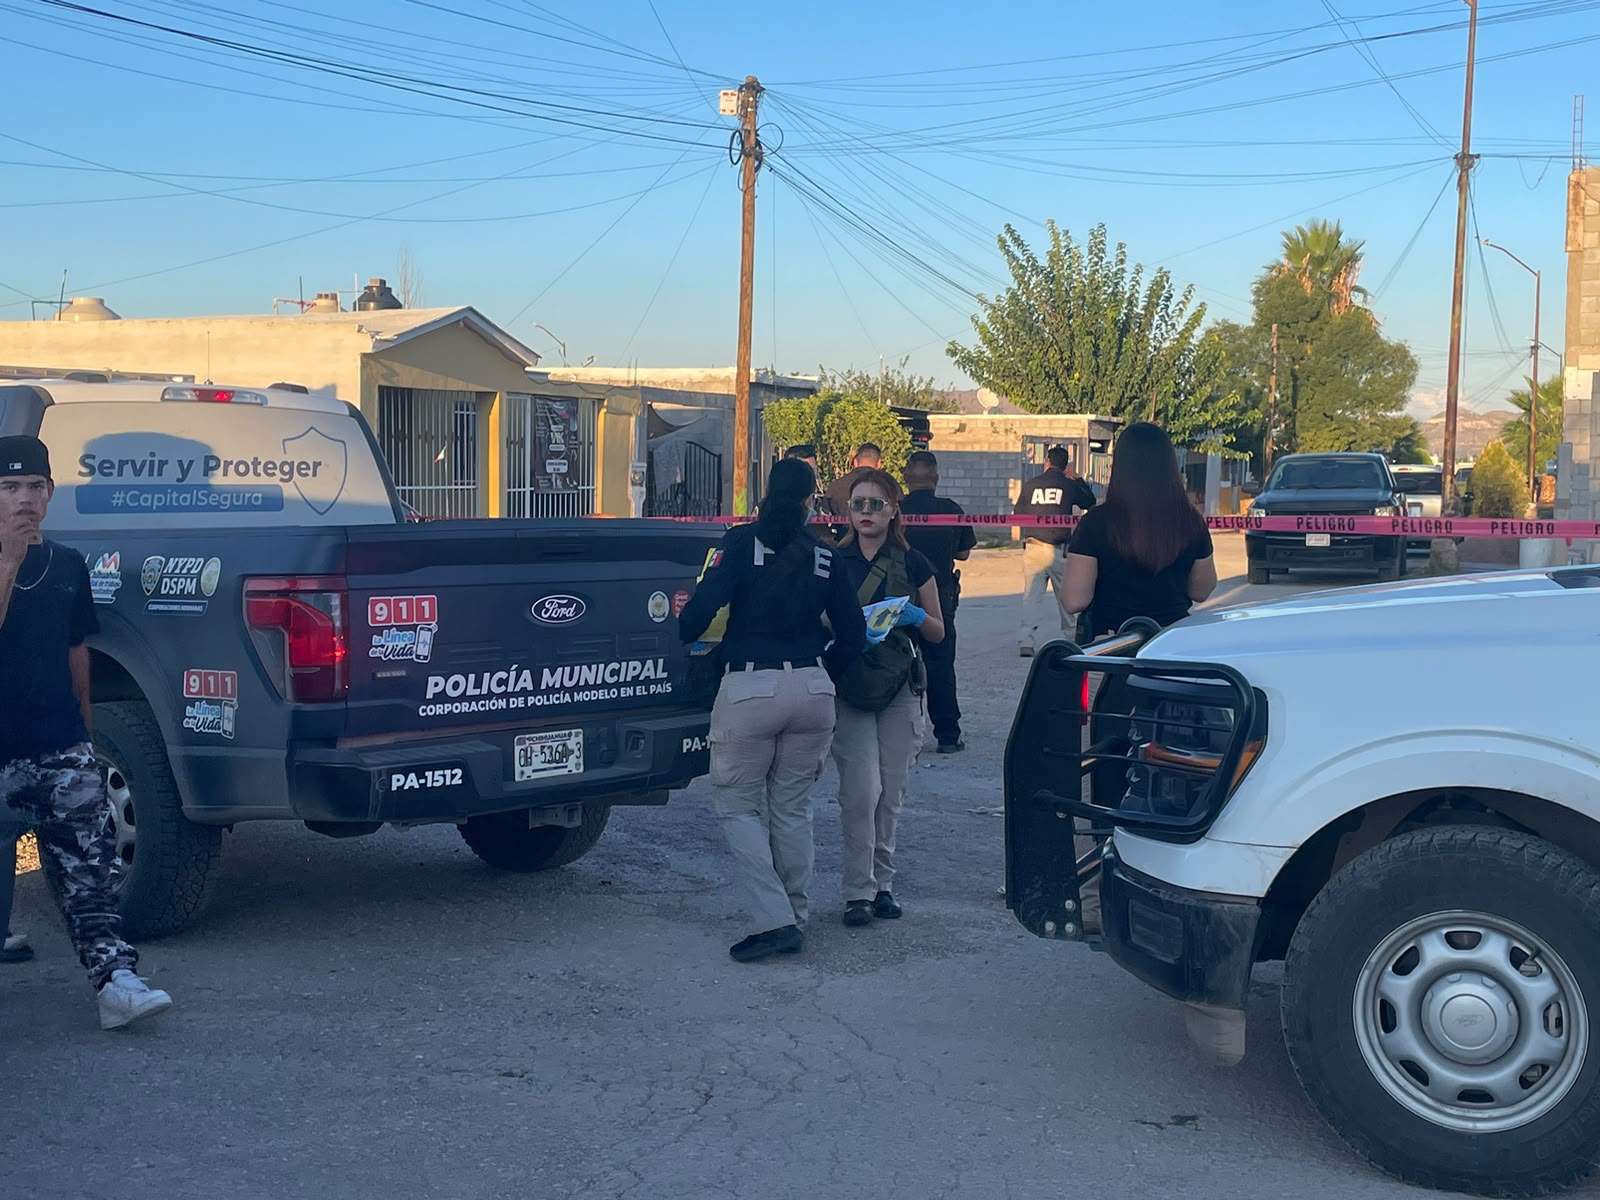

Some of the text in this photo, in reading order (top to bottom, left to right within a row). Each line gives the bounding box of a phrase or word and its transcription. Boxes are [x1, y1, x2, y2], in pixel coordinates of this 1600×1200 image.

[77, 452, 322, 483] Servir y Proteger
[111, 489, 262, 510] #CapitalSegura
[1031, 488, 1063, 505] AEI
[957, 514, 1007, 524] PELIGRO
[1036, 515, 1080, 525] PELIGR
[1206, 516, 1263, 529] PELIGRO
[1296, 516, 1356, 532] PELIGRO
[1391, 519, 1453, 534] PELIGRO
[1490, 521, 1555, 535] PELIGRO
[163, 557, 205, 574] NYPD
[160, 577, 197, 595] DSPM
[375, 600, 430, 622] 911
[541, 598, 577, 618] Ford
[382, 644, 415, 660] Vida
[189, 674, 232, 695] 911
[425, 658, 669, 699] POLICÍA MUNICIPAL
[418, 682, 673, 717] CORPORACIÓN DE POLICÍA MODELO EN EL PAÍS
[391, 767, 463, 791] PA-1512
